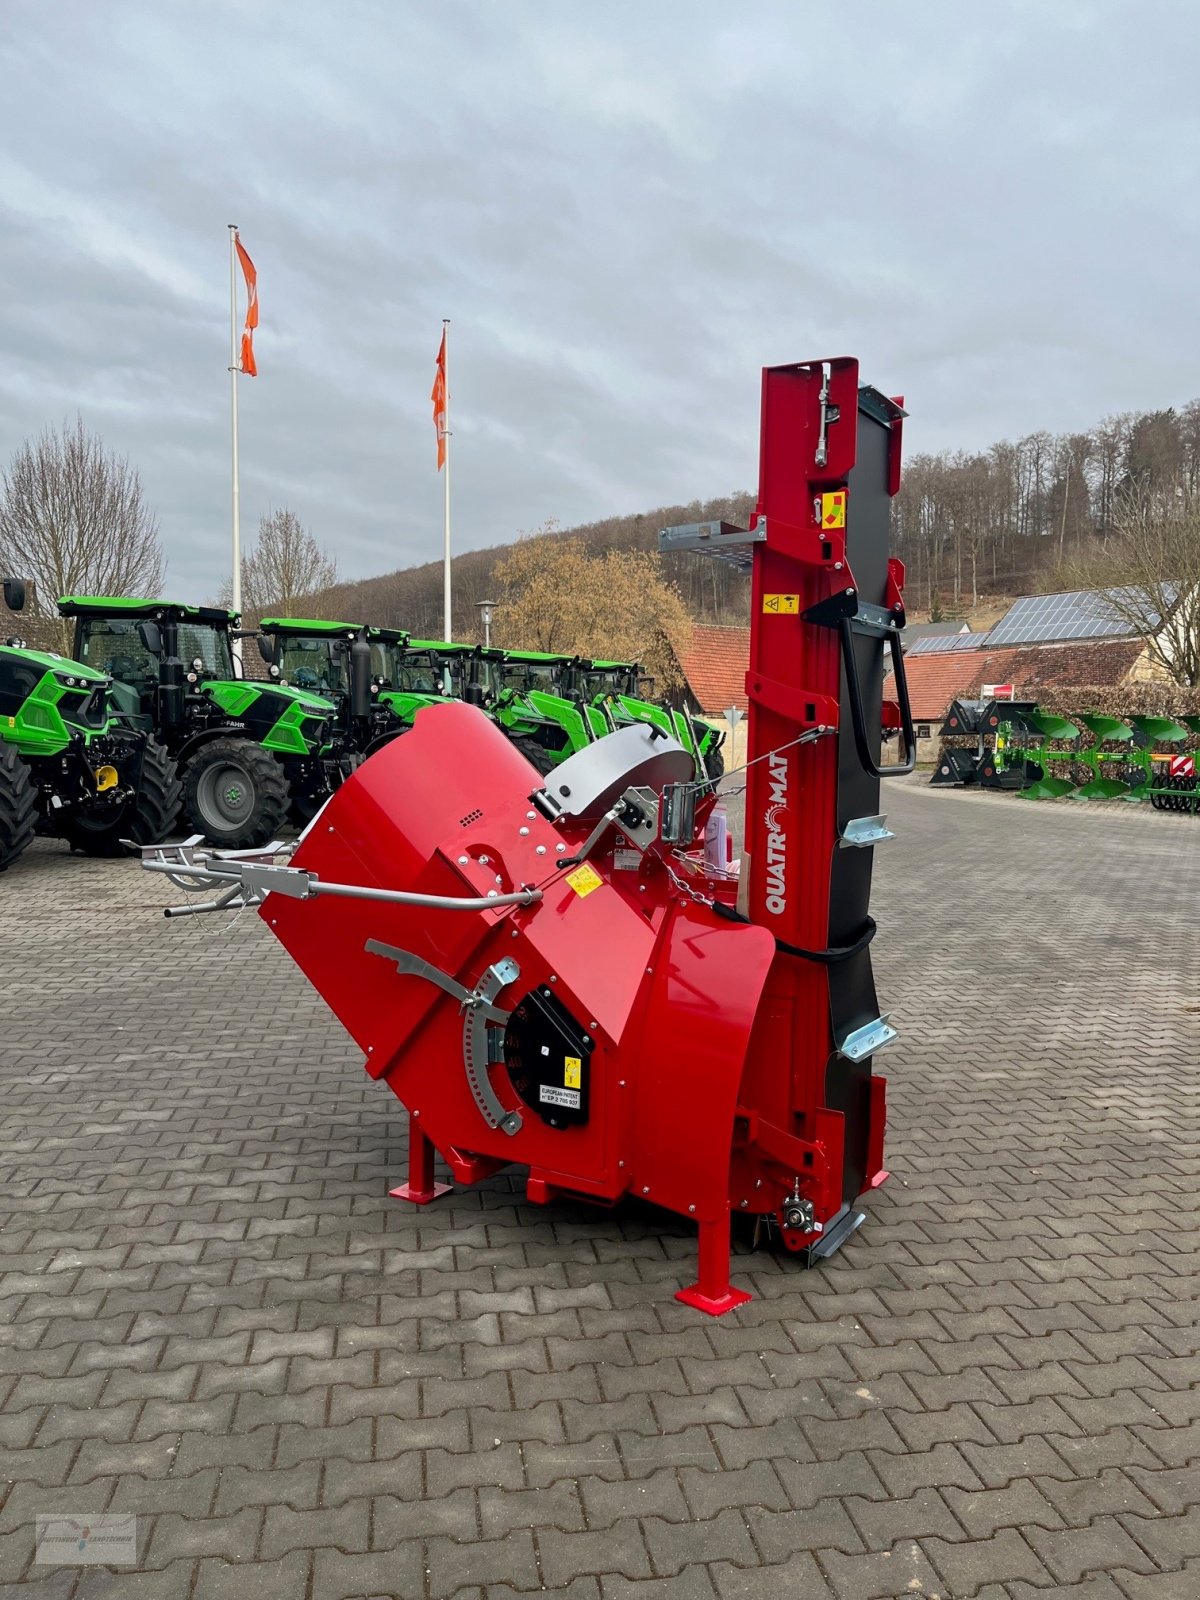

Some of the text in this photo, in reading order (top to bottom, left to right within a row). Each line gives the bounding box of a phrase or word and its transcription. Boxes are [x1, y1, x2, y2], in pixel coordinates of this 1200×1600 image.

[220, 720, 245, 728] -FAHR
[764, 752, 789, 915] QUATROMAT
[541, 1088, 578, 1100] EUROPEAN PATENT
